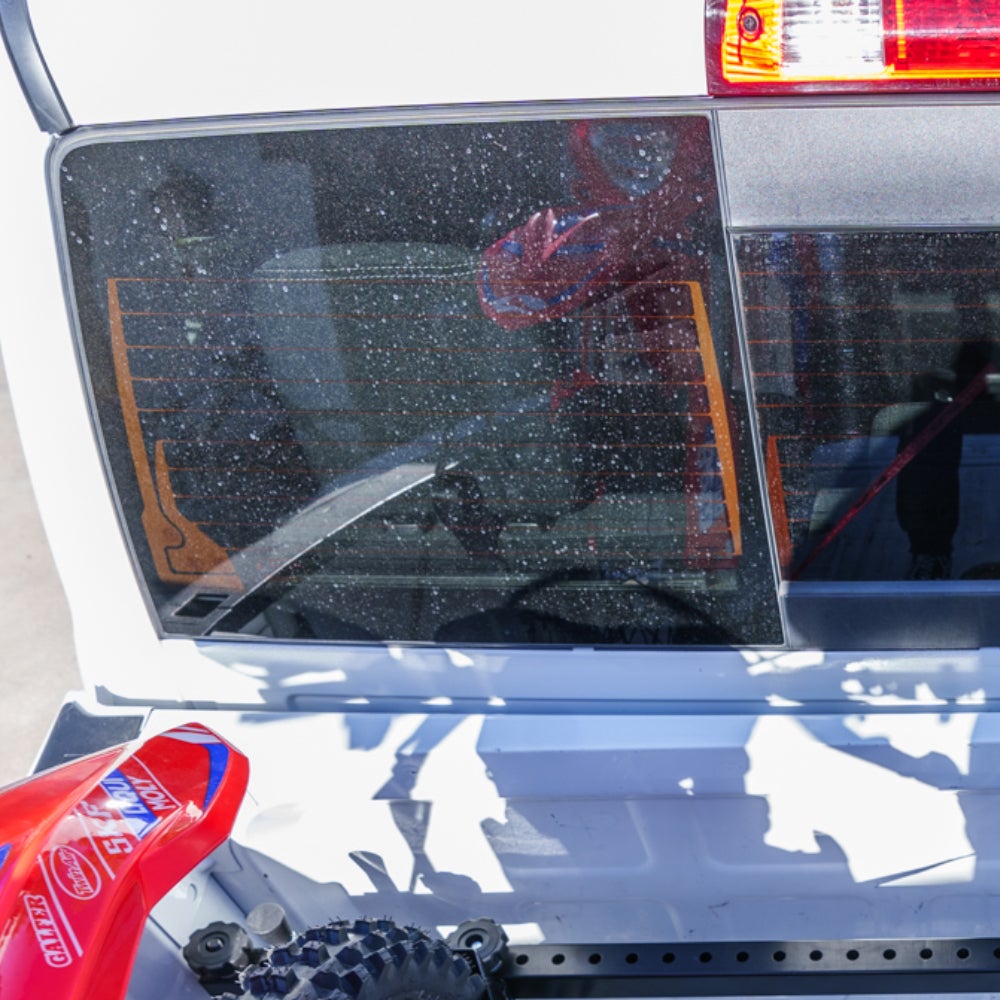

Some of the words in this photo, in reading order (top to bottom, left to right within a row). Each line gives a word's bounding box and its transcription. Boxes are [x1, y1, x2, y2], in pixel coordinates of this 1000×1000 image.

[126, 775, 176, 811] MOLY
[80, 800, 134, 855] SKF
[26, 896, 70, 966] GALFER
